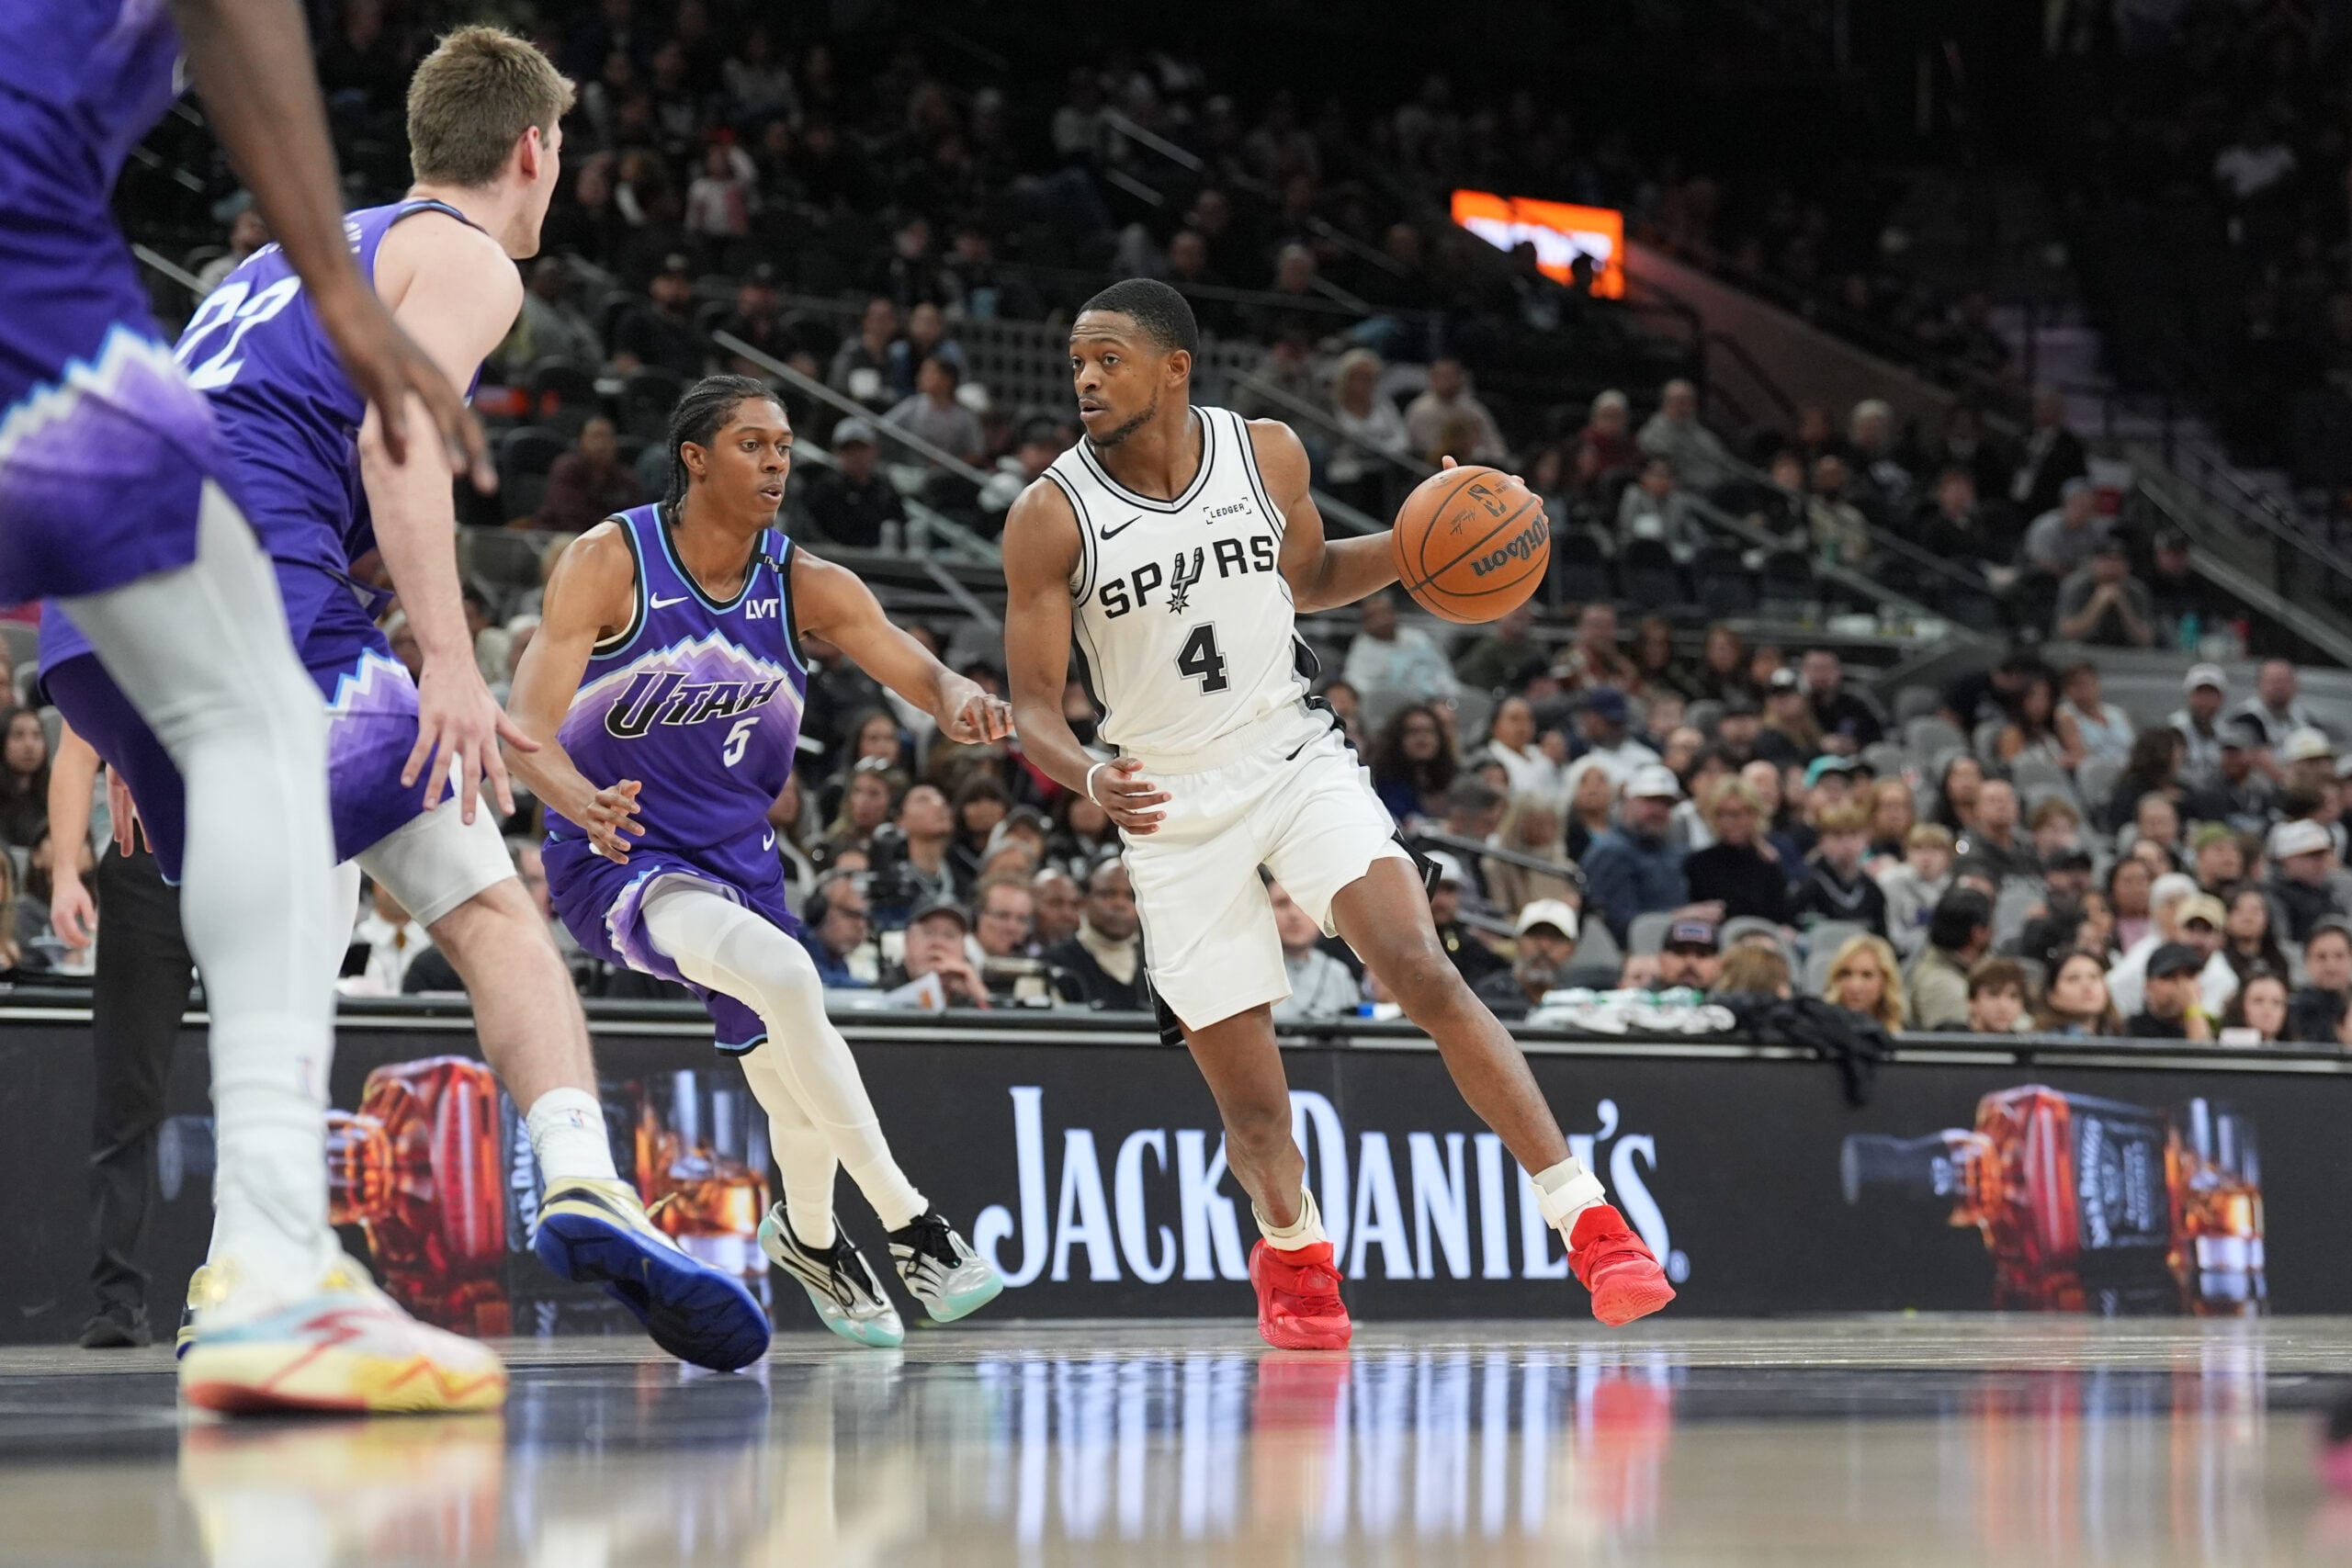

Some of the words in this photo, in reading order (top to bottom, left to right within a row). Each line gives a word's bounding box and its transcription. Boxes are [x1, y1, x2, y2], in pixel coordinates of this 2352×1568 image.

[1210, 502, 1245, 518] LEDGER
[1099, 536, 1274, 619] SPURS
[1470, 514, 1549, 577] Wilson
[745, 598, 779, 620] LVT
[1174, 621, 1231, 696] 4
[605, 671, 787, 739] UTAH
[723, 716, 761, 768] 5
[974, 1087, 1250, 1287] JACK
[1286, 1089, 1670, 1280] DANI'S
